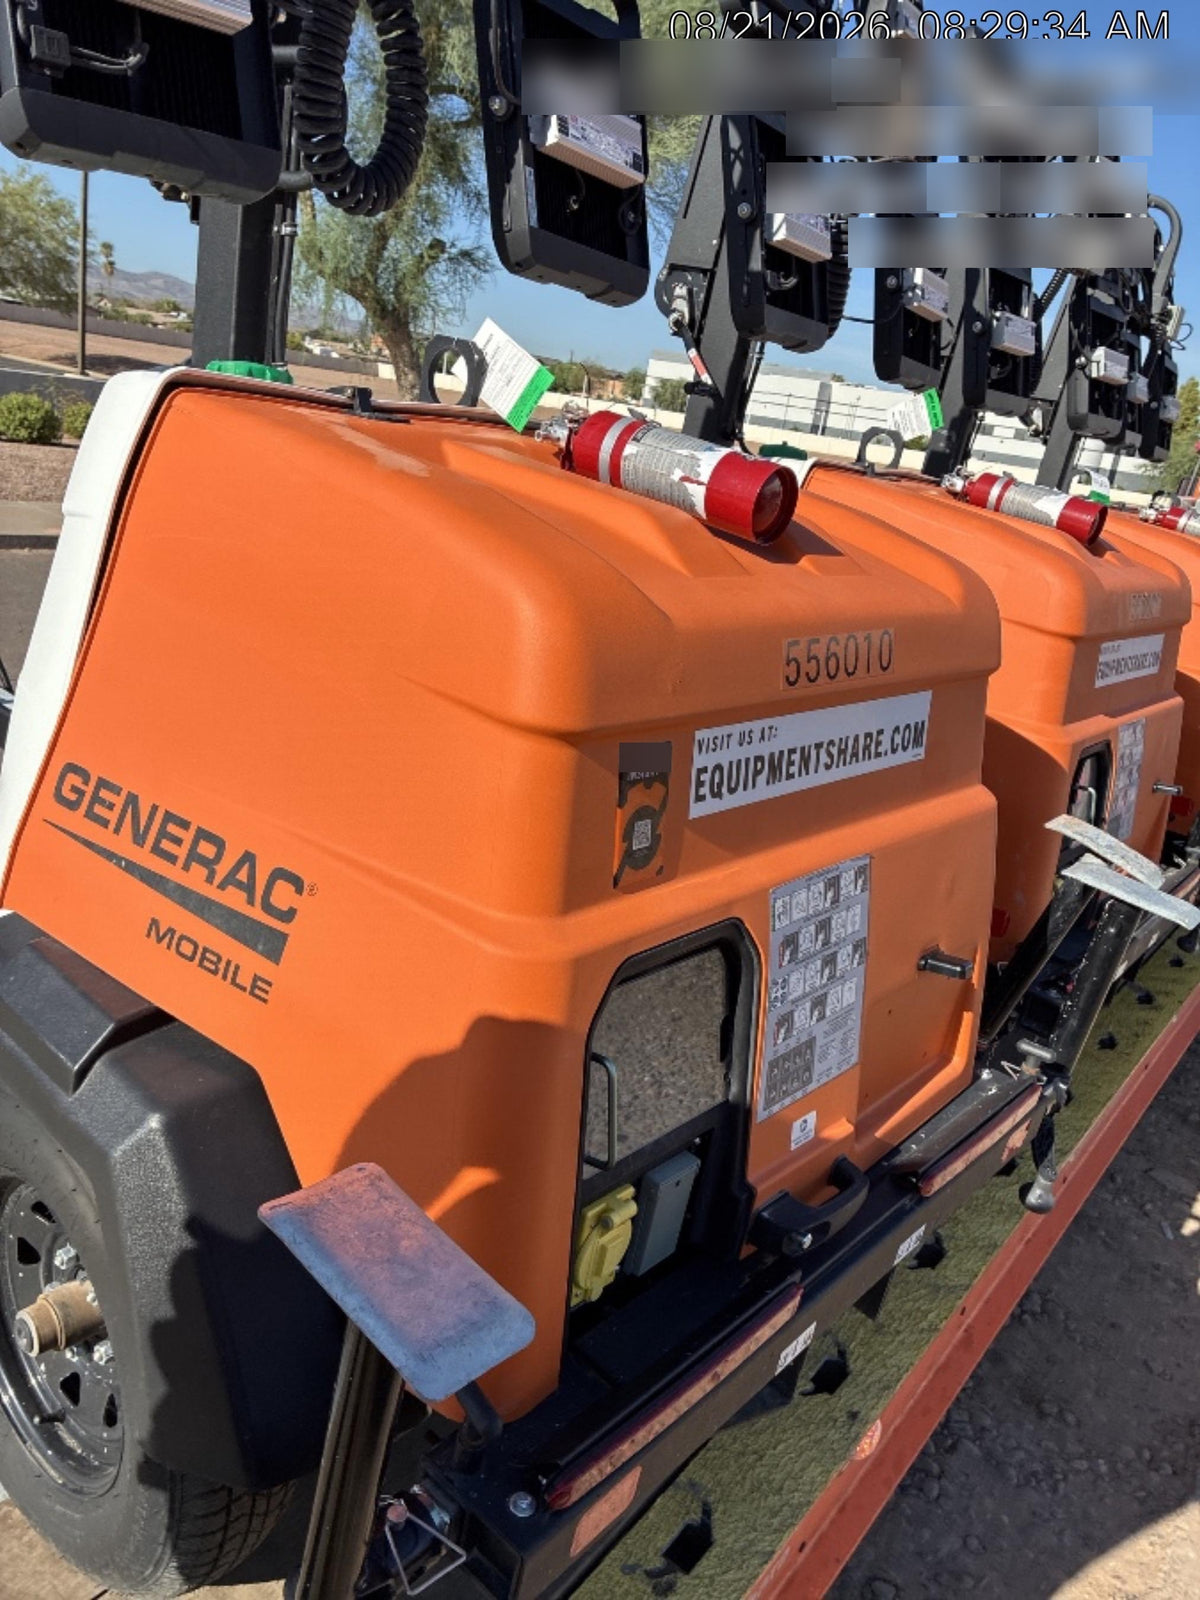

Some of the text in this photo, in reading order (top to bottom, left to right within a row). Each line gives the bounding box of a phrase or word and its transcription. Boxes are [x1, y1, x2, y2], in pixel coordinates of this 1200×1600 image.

[785, 629, 893, 687] 556010
[694, 720, 926, 804] EQUIPMENTSHARE.COM
[697, 725, 778, 755] VISIT US AT:
[53, 762, 304, 924] GENERAC
[145, 917, 273, 1005] MOBILE
